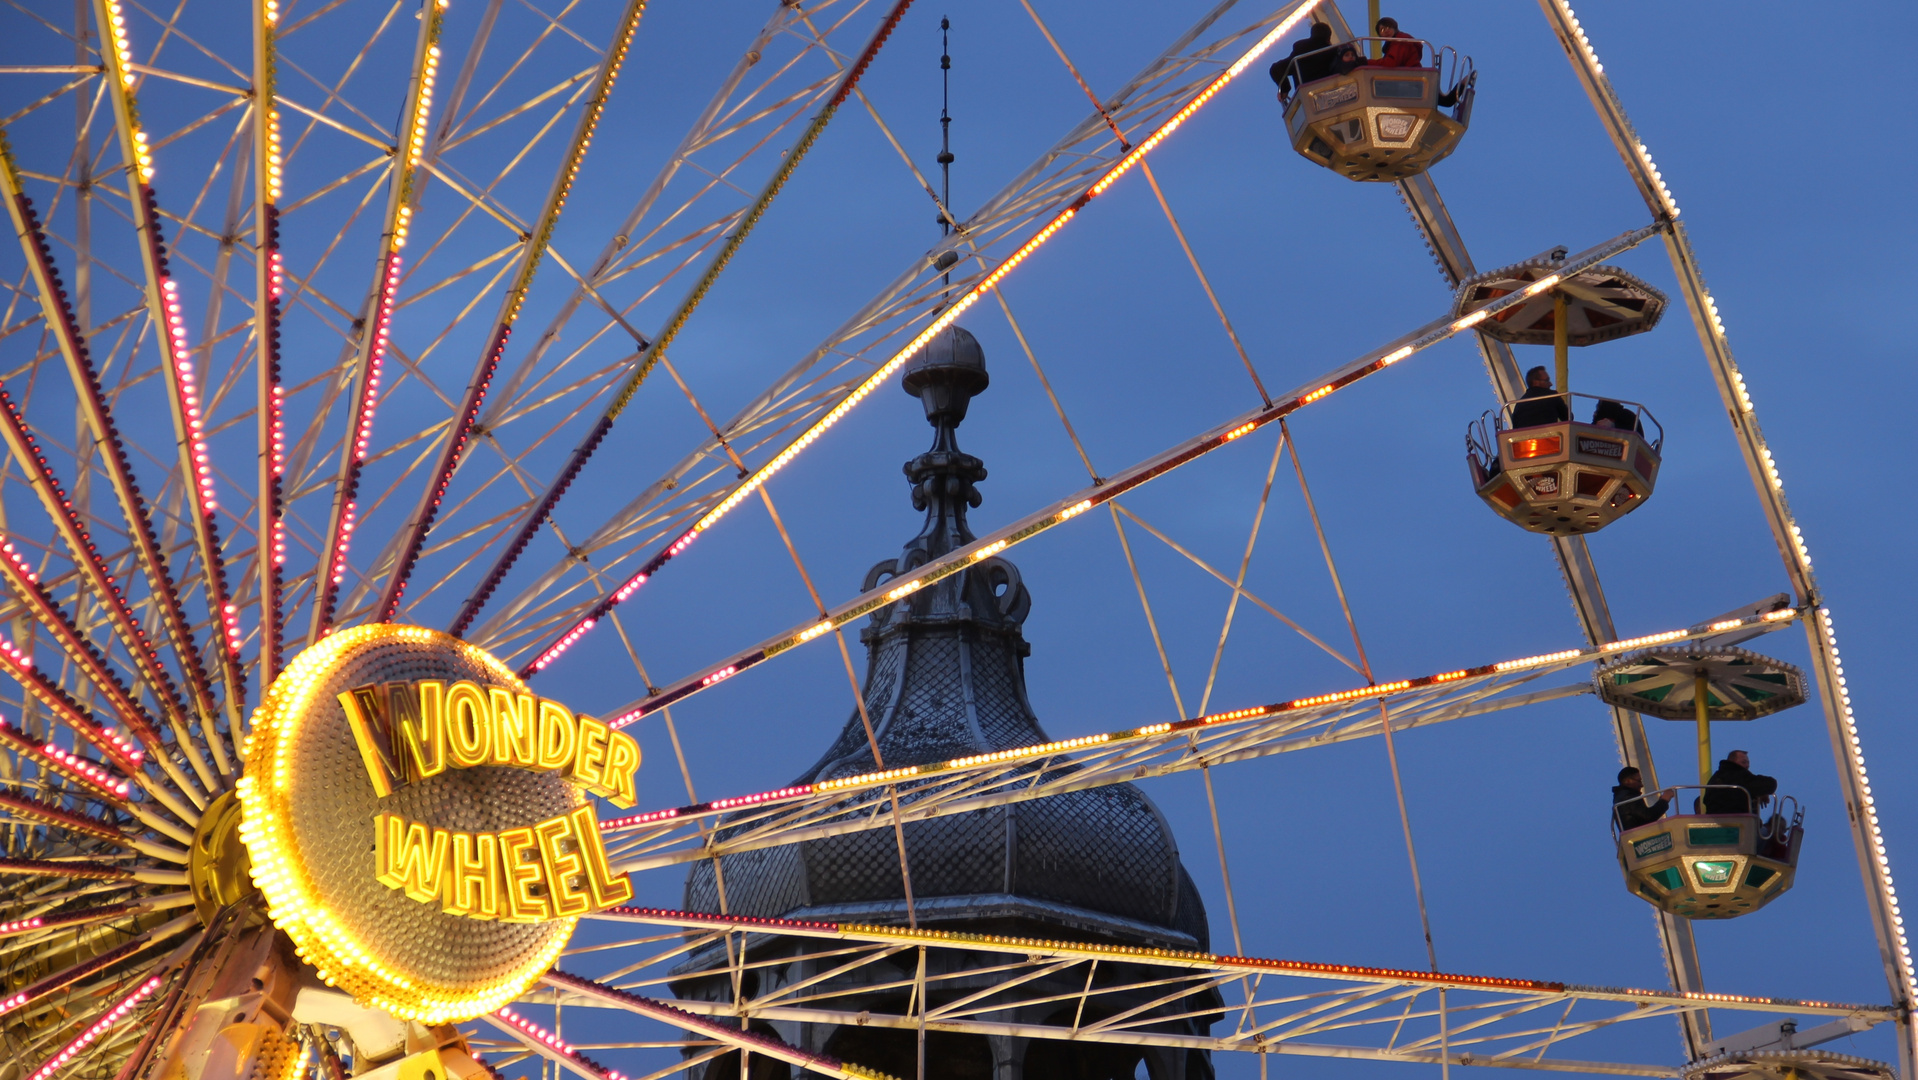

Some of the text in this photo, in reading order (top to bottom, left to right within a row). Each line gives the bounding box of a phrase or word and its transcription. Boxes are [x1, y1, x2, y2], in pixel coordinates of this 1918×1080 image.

[1597, 446, 1622, 457] WHEEL
[1535, 482, 1557, 492] WHEEL
[337, 680, 641, 809] WONDER
[375, 803, 633, 924] WHEEL
